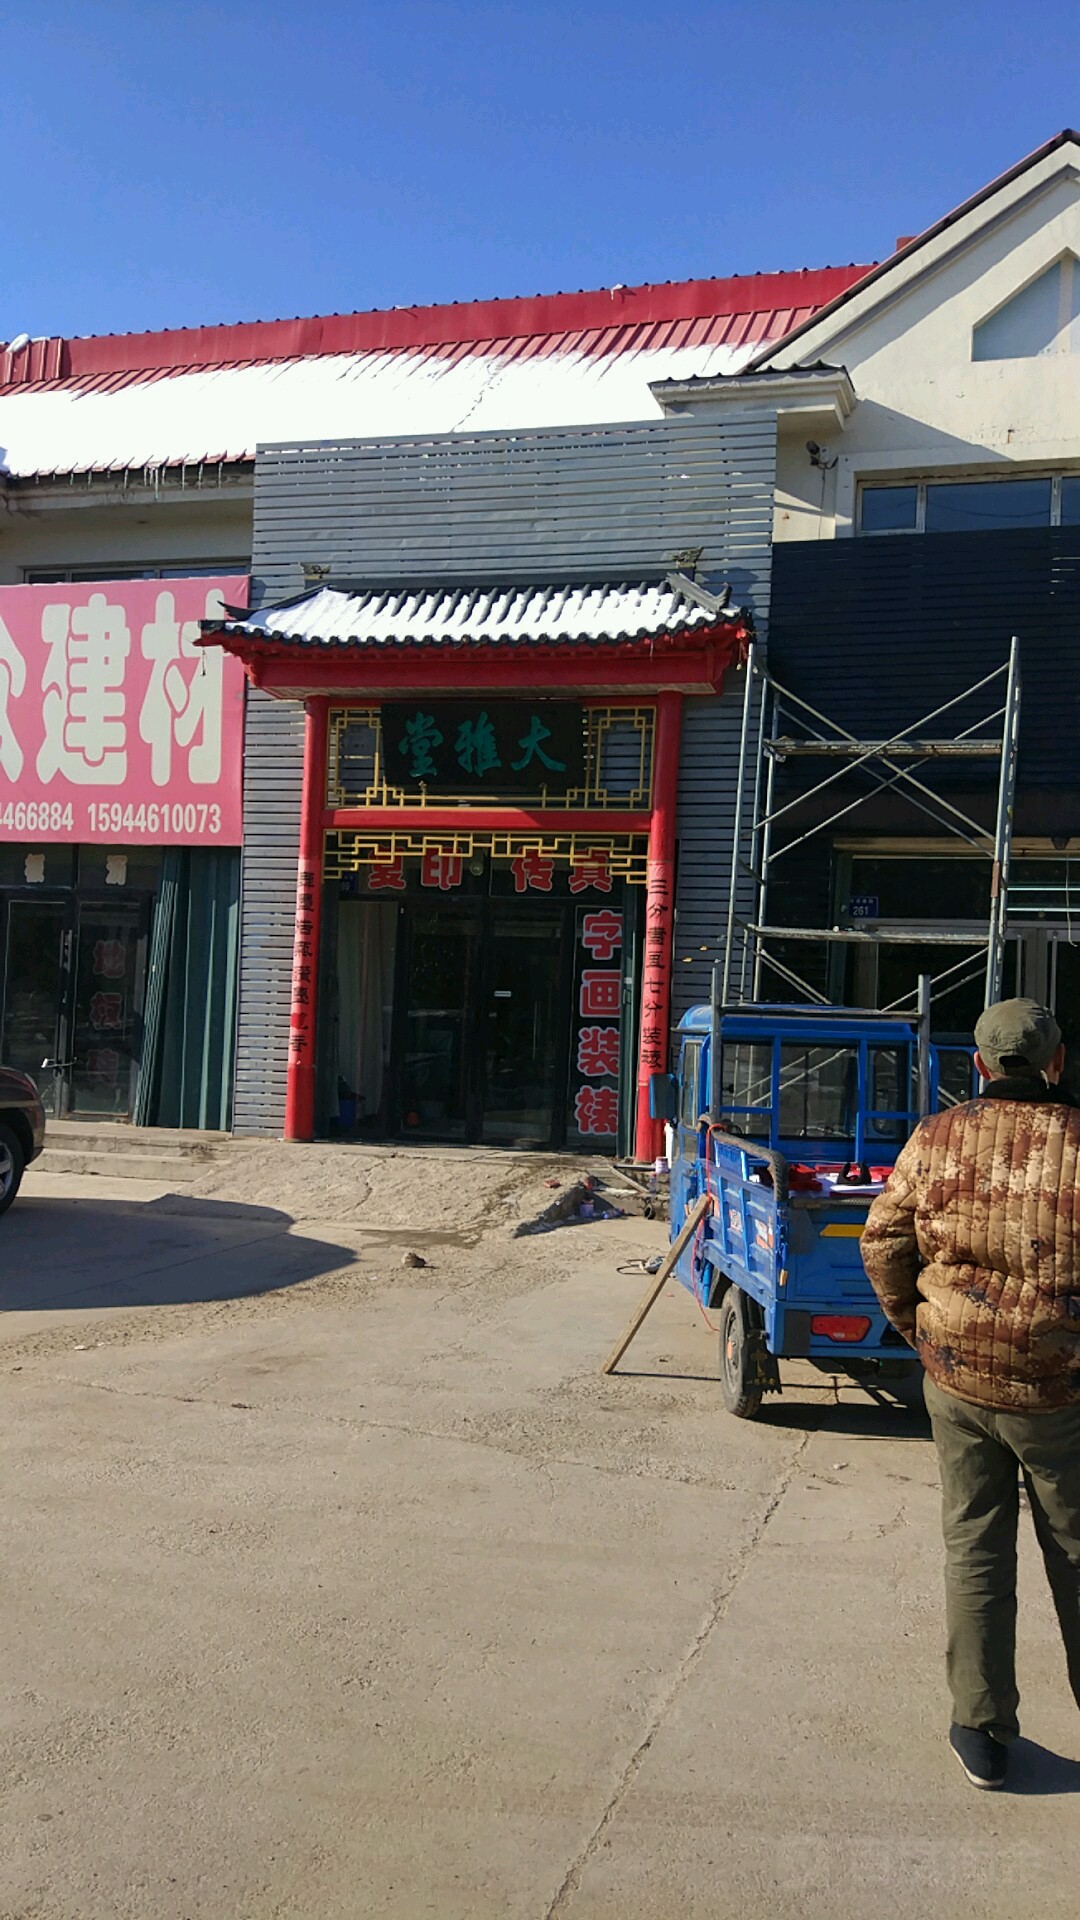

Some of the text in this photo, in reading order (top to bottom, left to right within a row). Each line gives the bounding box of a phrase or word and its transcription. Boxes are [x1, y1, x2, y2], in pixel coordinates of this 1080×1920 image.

[400, 711, 566, 777] 大雅堂
[0, 801, 222, 833] 466884 15944610073
[852, 905, 869, 916] 261
